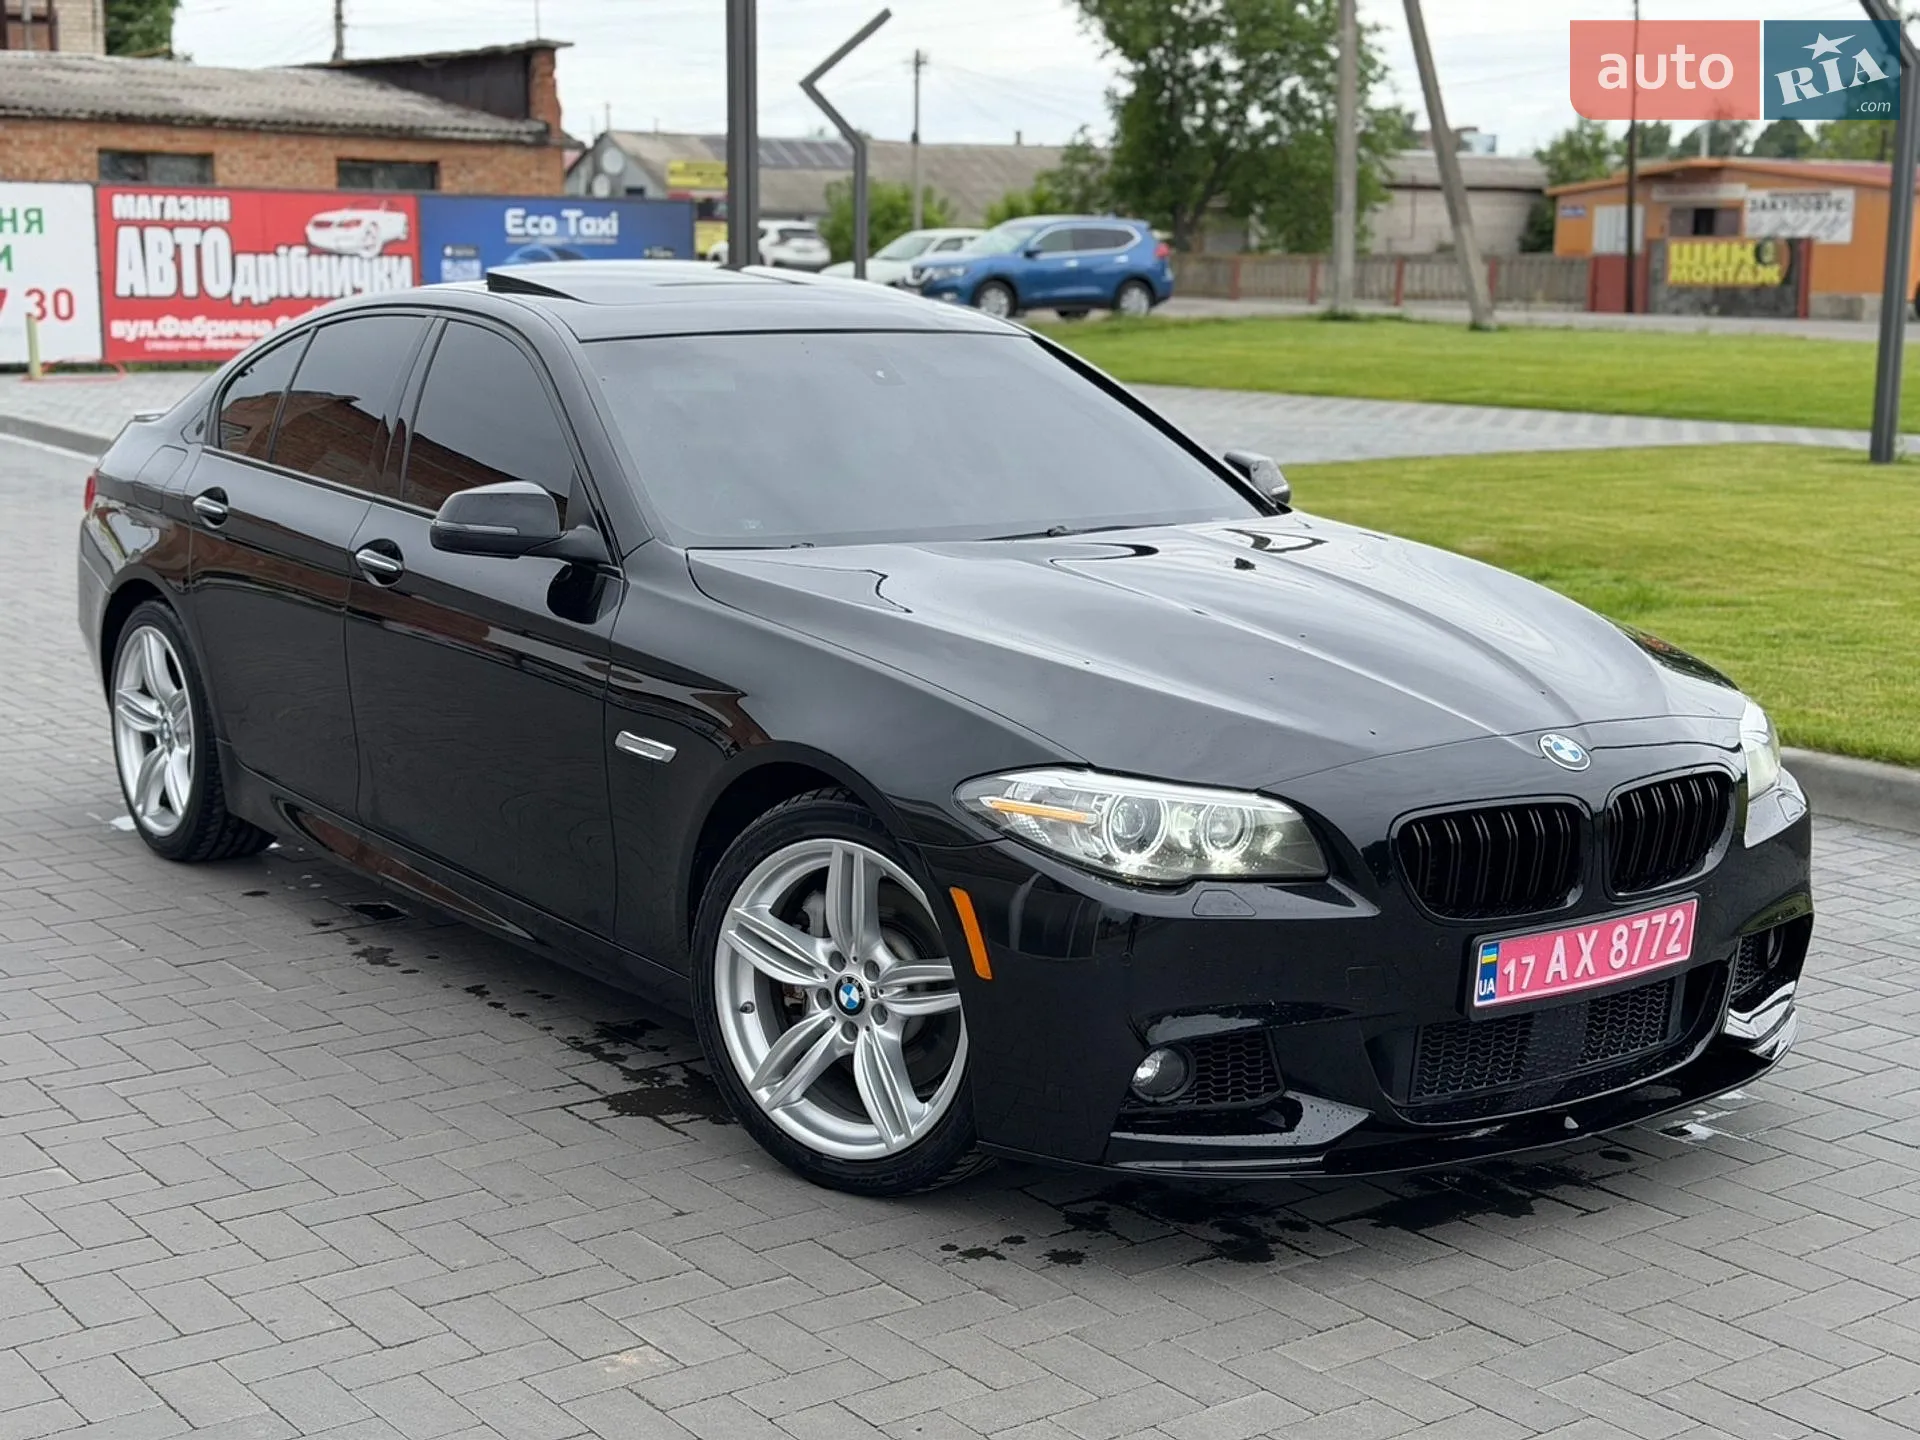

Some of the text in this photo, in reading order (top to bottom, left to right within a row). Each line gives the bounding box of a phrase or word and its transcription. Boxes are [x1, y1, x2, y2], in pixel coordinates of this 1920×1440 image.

[111, 194, 231, 222] МАГАЗИН
[505, 208, 619, 237] Eco Taxi
[1669, 263, 1781, 284] МОНТАЖ
[25, 287, 75, 321] 30
[1503, 909, 1685, 993] 17 AX 8772
[1478, 979, 1496, 996] UA
